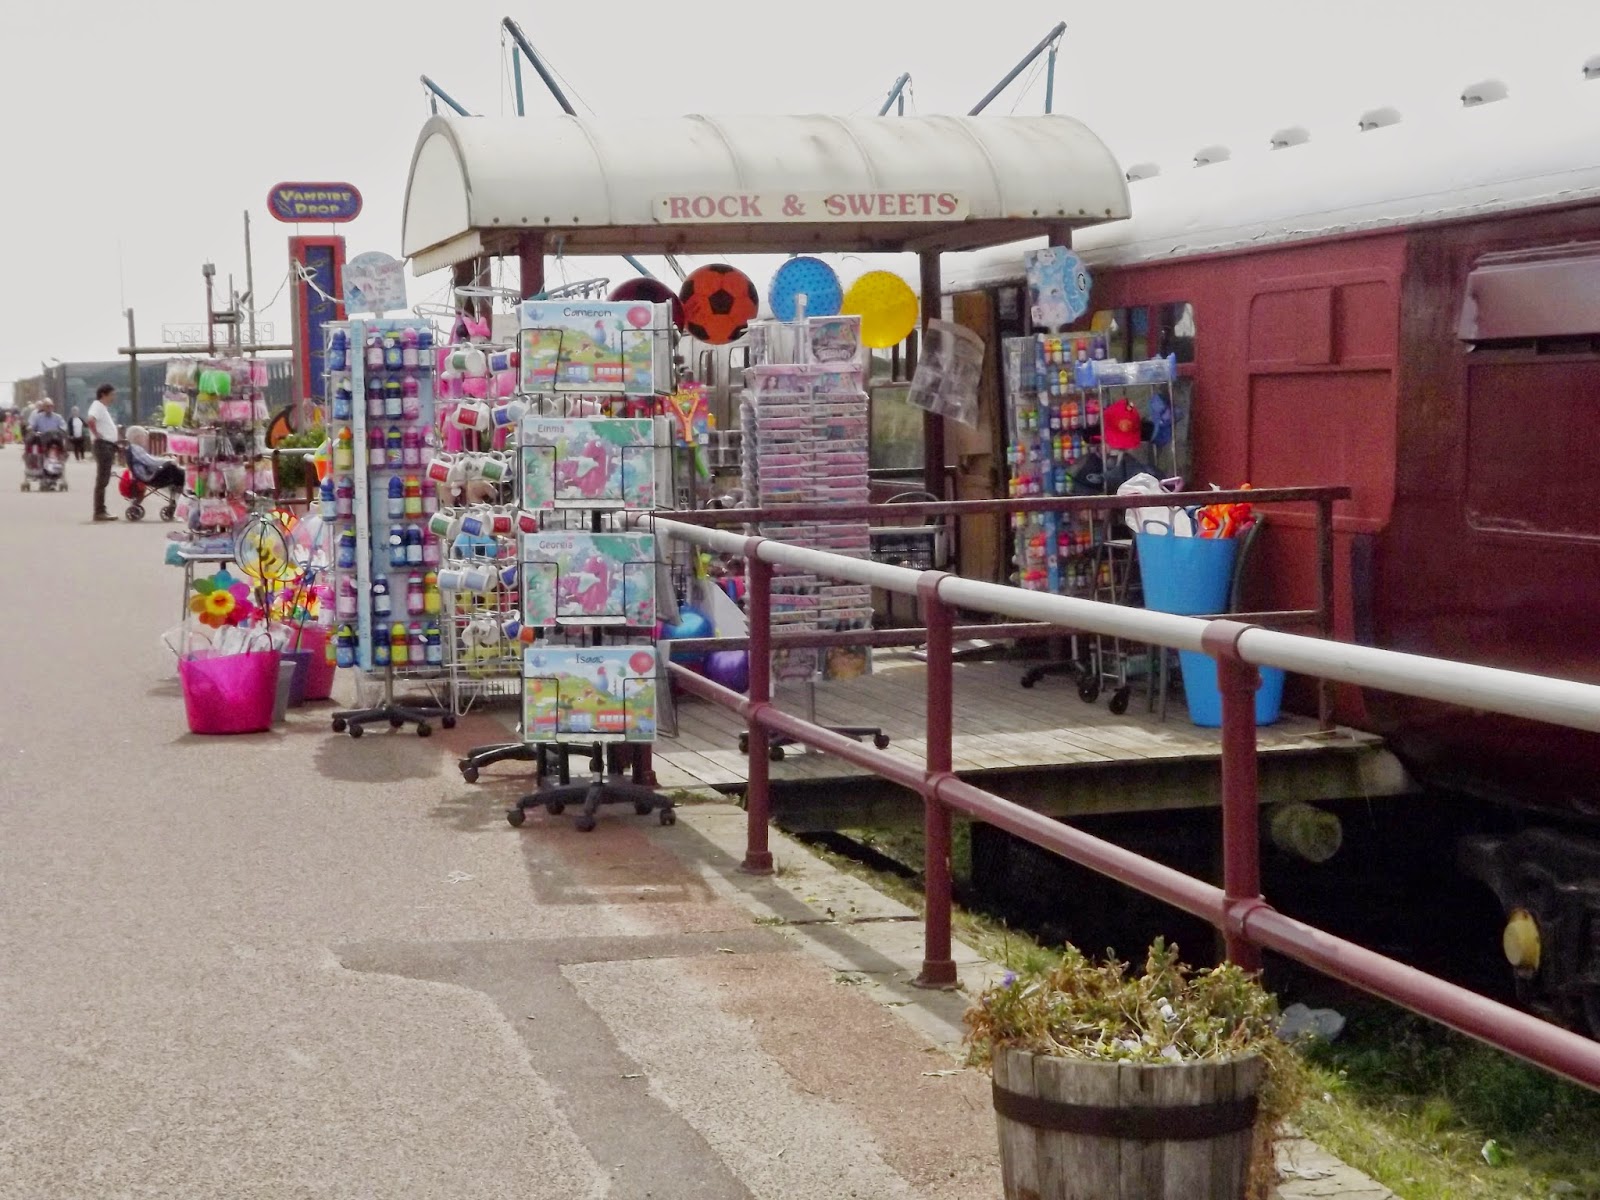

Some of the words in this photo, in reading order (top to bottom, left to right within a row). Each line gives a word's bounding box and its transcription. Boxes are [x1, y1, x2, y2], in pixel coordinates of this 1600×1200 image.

[279, 190, 351, 202] VAMPIRE
[295, 203, 340, 214] DROP
[669, 195, 763, 219] ROCK
[781, 193, 806, 217] &
[826, 192, 958, 217] SWEETS
[563, 307, 612, 318] Cameron
[537, 424, 565, 434] Emma
[575, 653, 605, 665] Isaac
